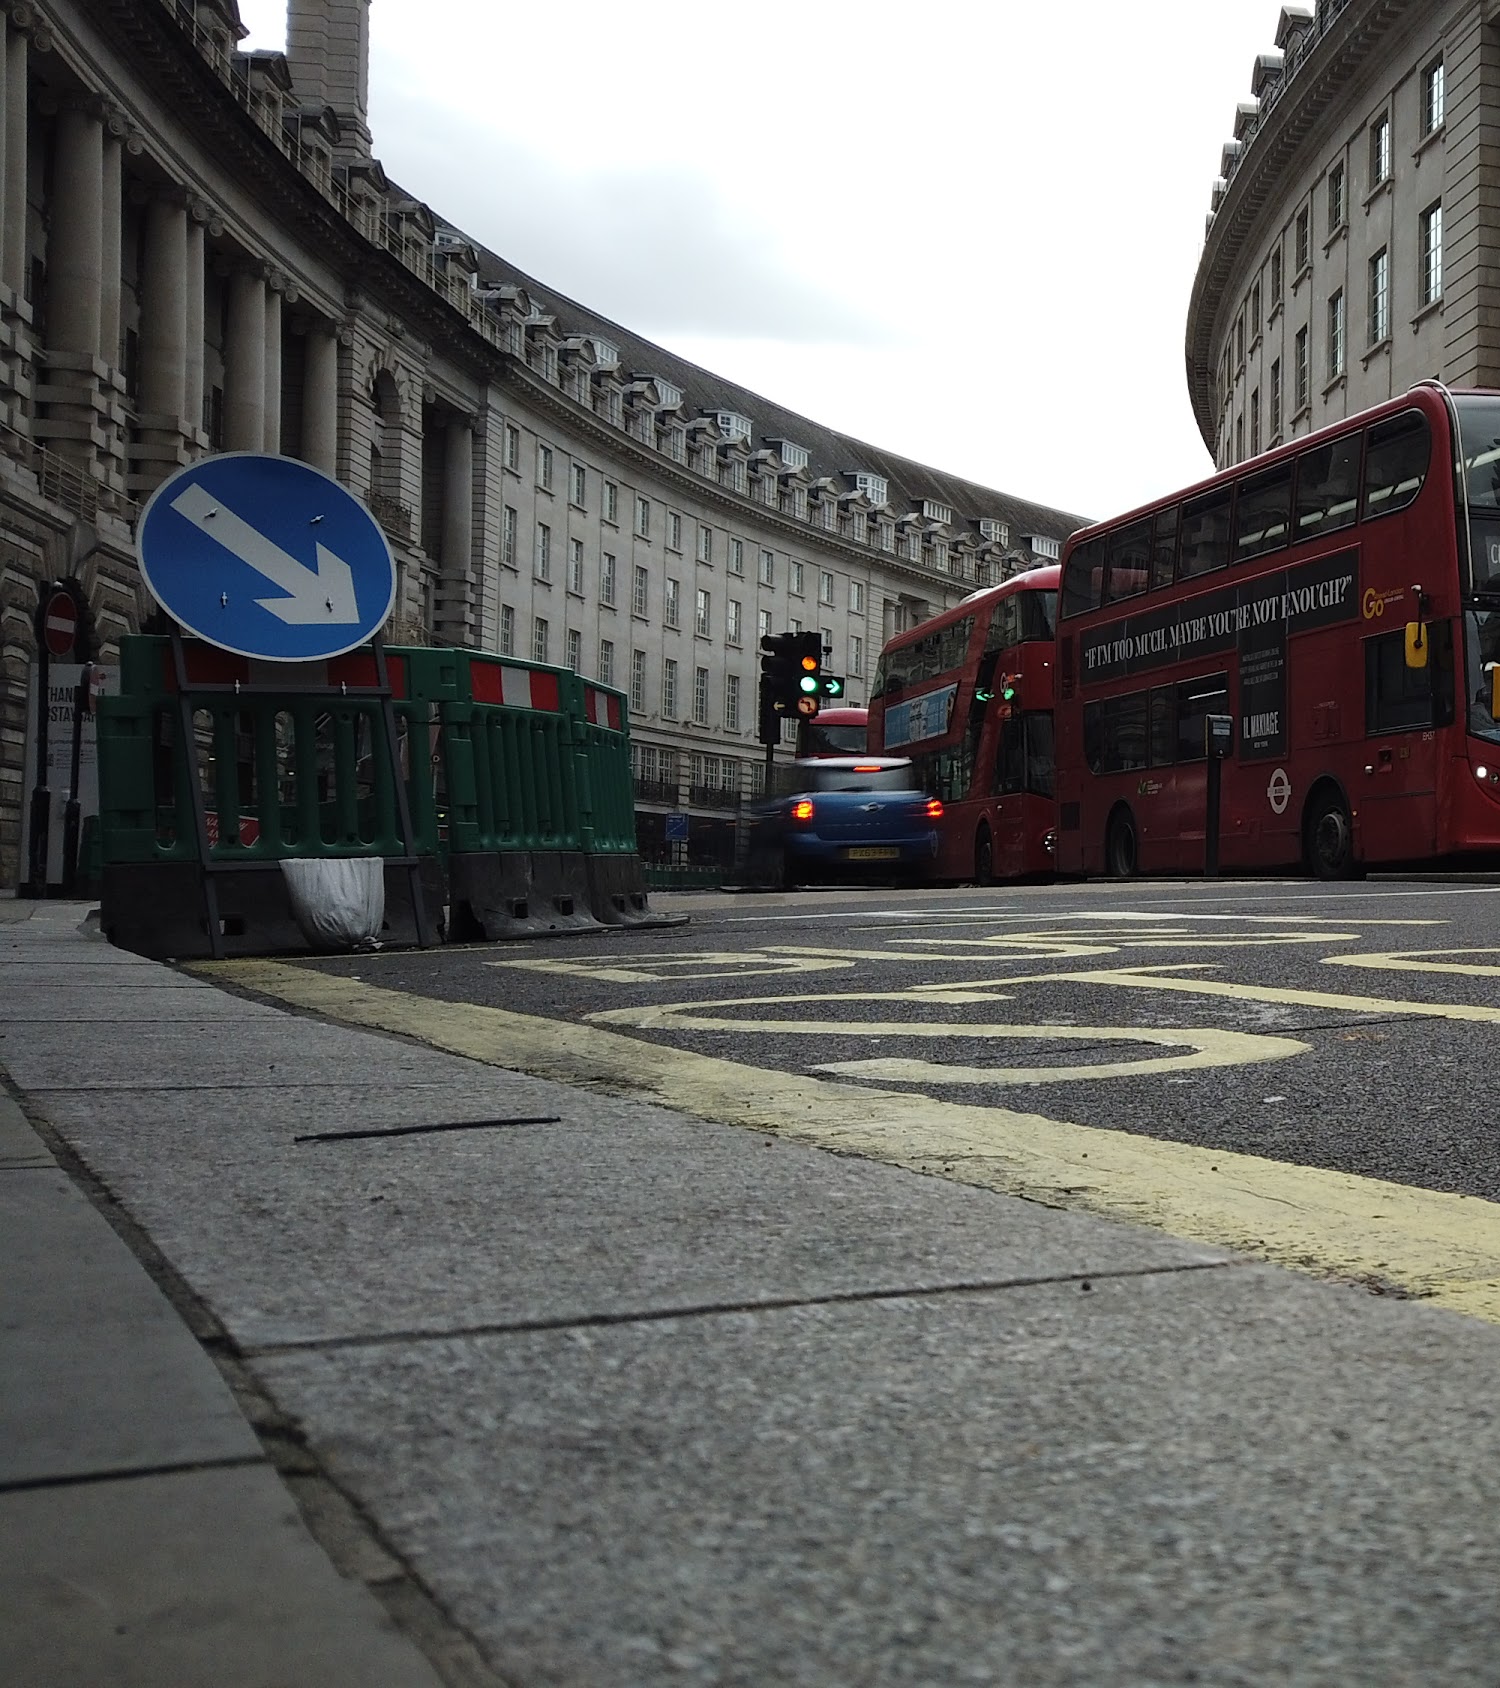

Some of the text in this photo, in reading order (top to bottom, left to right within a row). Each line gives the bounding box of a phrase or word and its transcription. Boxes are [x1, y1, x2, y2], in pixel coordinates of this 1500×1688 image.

[1363, 587, 1384, 619] Go
[1112, 637, 1134, 662] TOO
[1135, 628, 1168, 657] MUCH,
[1169, 617, 1207, 648] MAYBE
[1208, 604, 1251, 637] YOU'RE
[1252, 596, 1279, 626] NOT
[1242, 711, 1279, 739] IL MAKIAGE
[481, 928, 1361, 983] BUS
